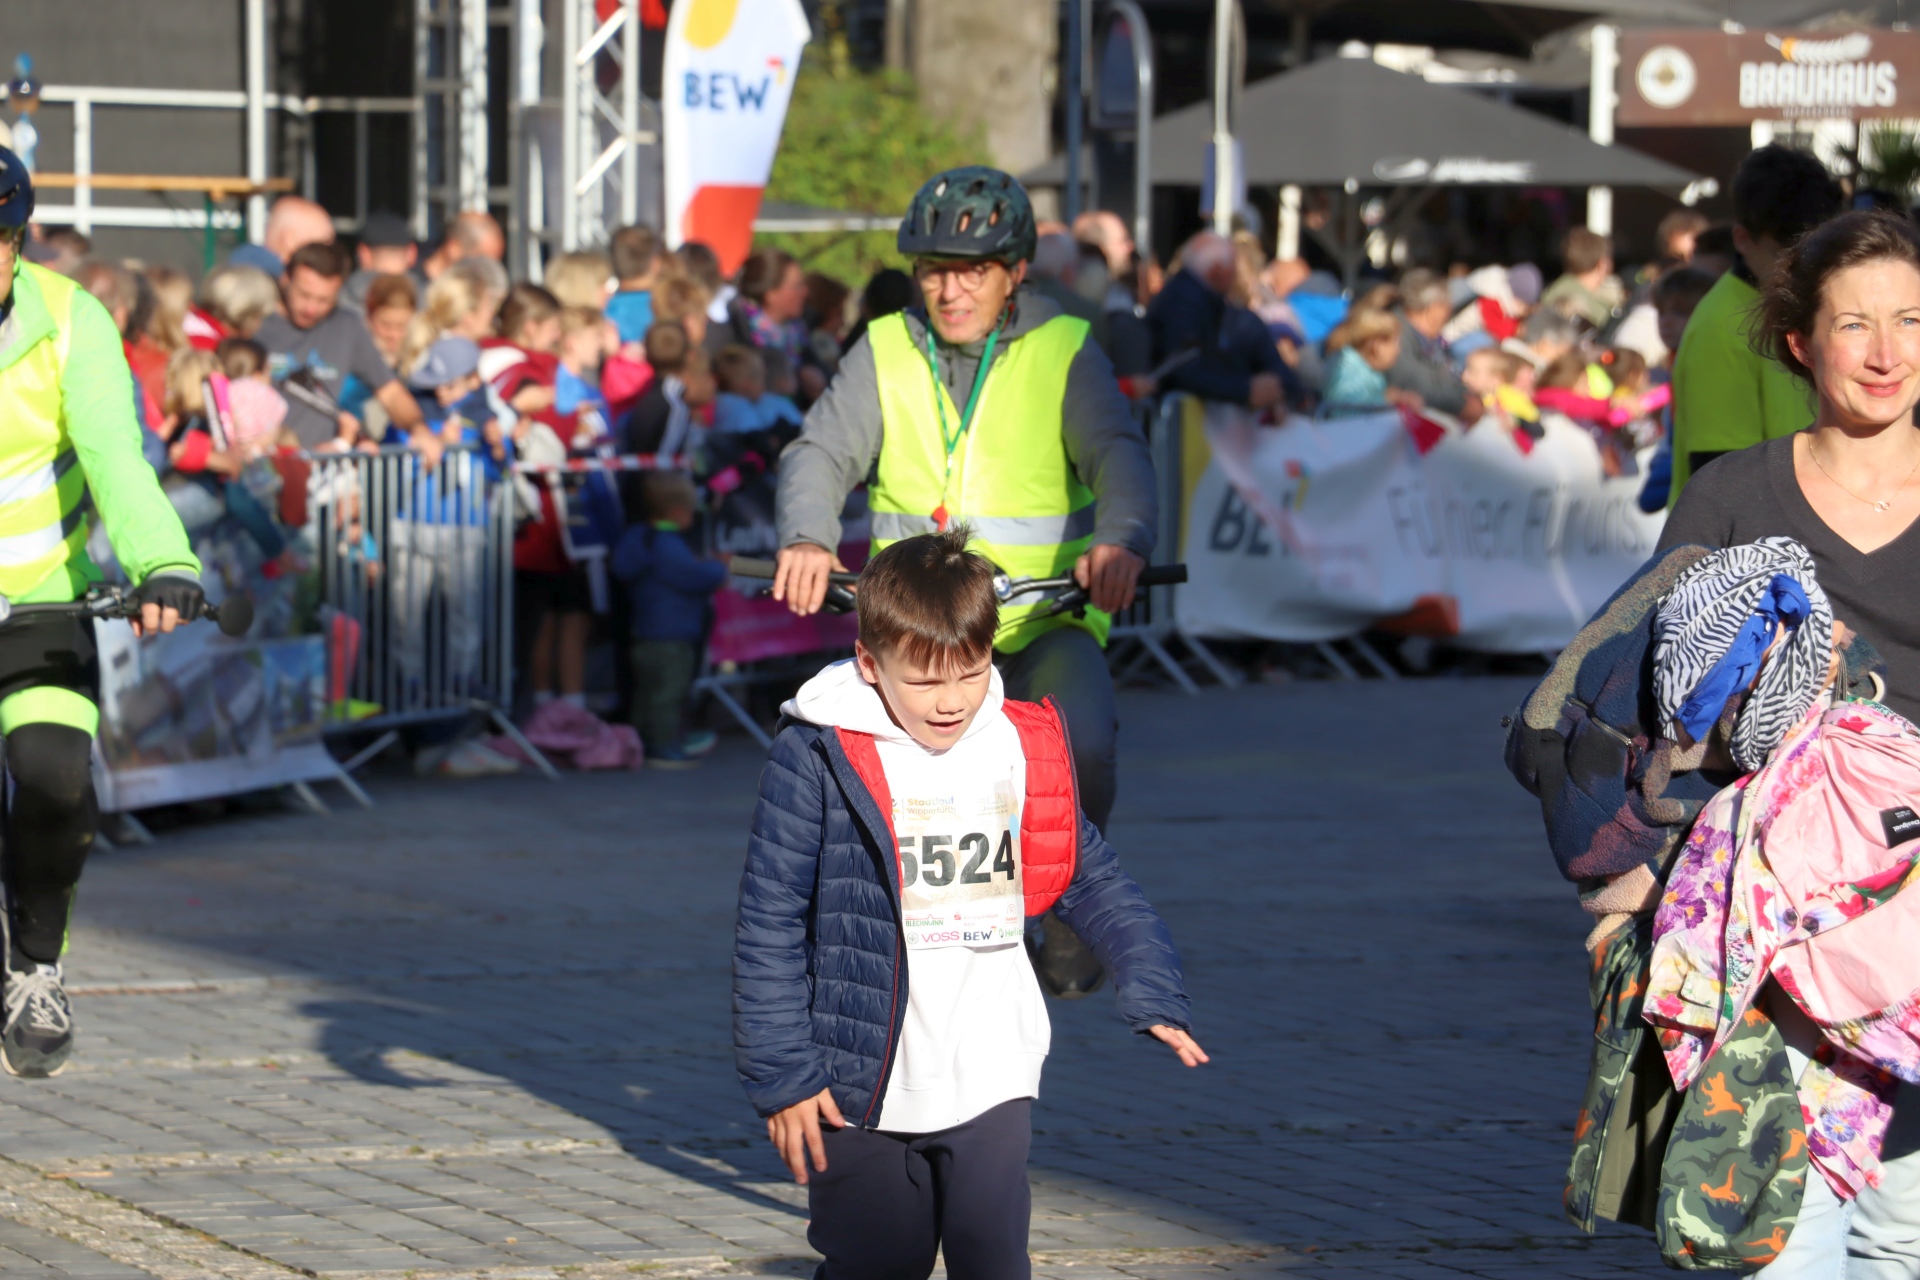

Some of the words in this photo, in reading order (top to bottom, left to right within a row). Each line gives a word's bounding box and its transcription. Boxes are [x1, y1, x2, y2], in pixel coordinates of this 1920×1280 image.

[684, 72, 770, 111] BEW
[1739, 61, 1898, 109] BRAUHAUS
[1209, 483, 1296, 558] BE
[907, 806, 957, 816] Wipperfürth
[908, 796, 955, 806] Stadtlauf
[897, 829, 1015, 889] 5524
[921, 930, 960, 943] VOSS
[963, 930, 993, 941] BEW
